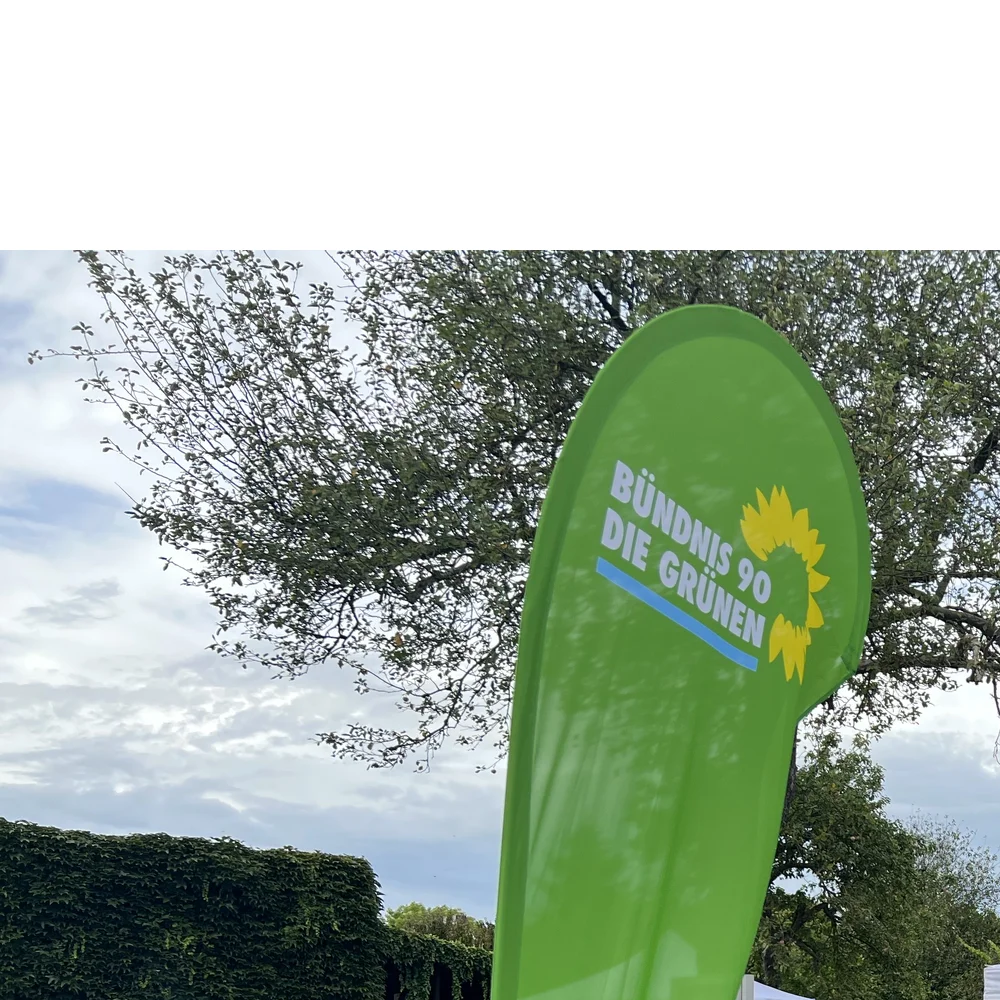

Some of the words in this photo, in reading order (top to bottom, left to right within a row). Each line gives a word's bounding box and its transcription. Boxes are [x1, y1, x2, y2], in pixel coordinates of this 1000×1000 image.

[601, 507, 652, 572] DIE
[659, 550, 766, 649] GRÜNEN
[610, 459, 733, 576] BÜNDNIS
[737, 557, 772, 604] 90
